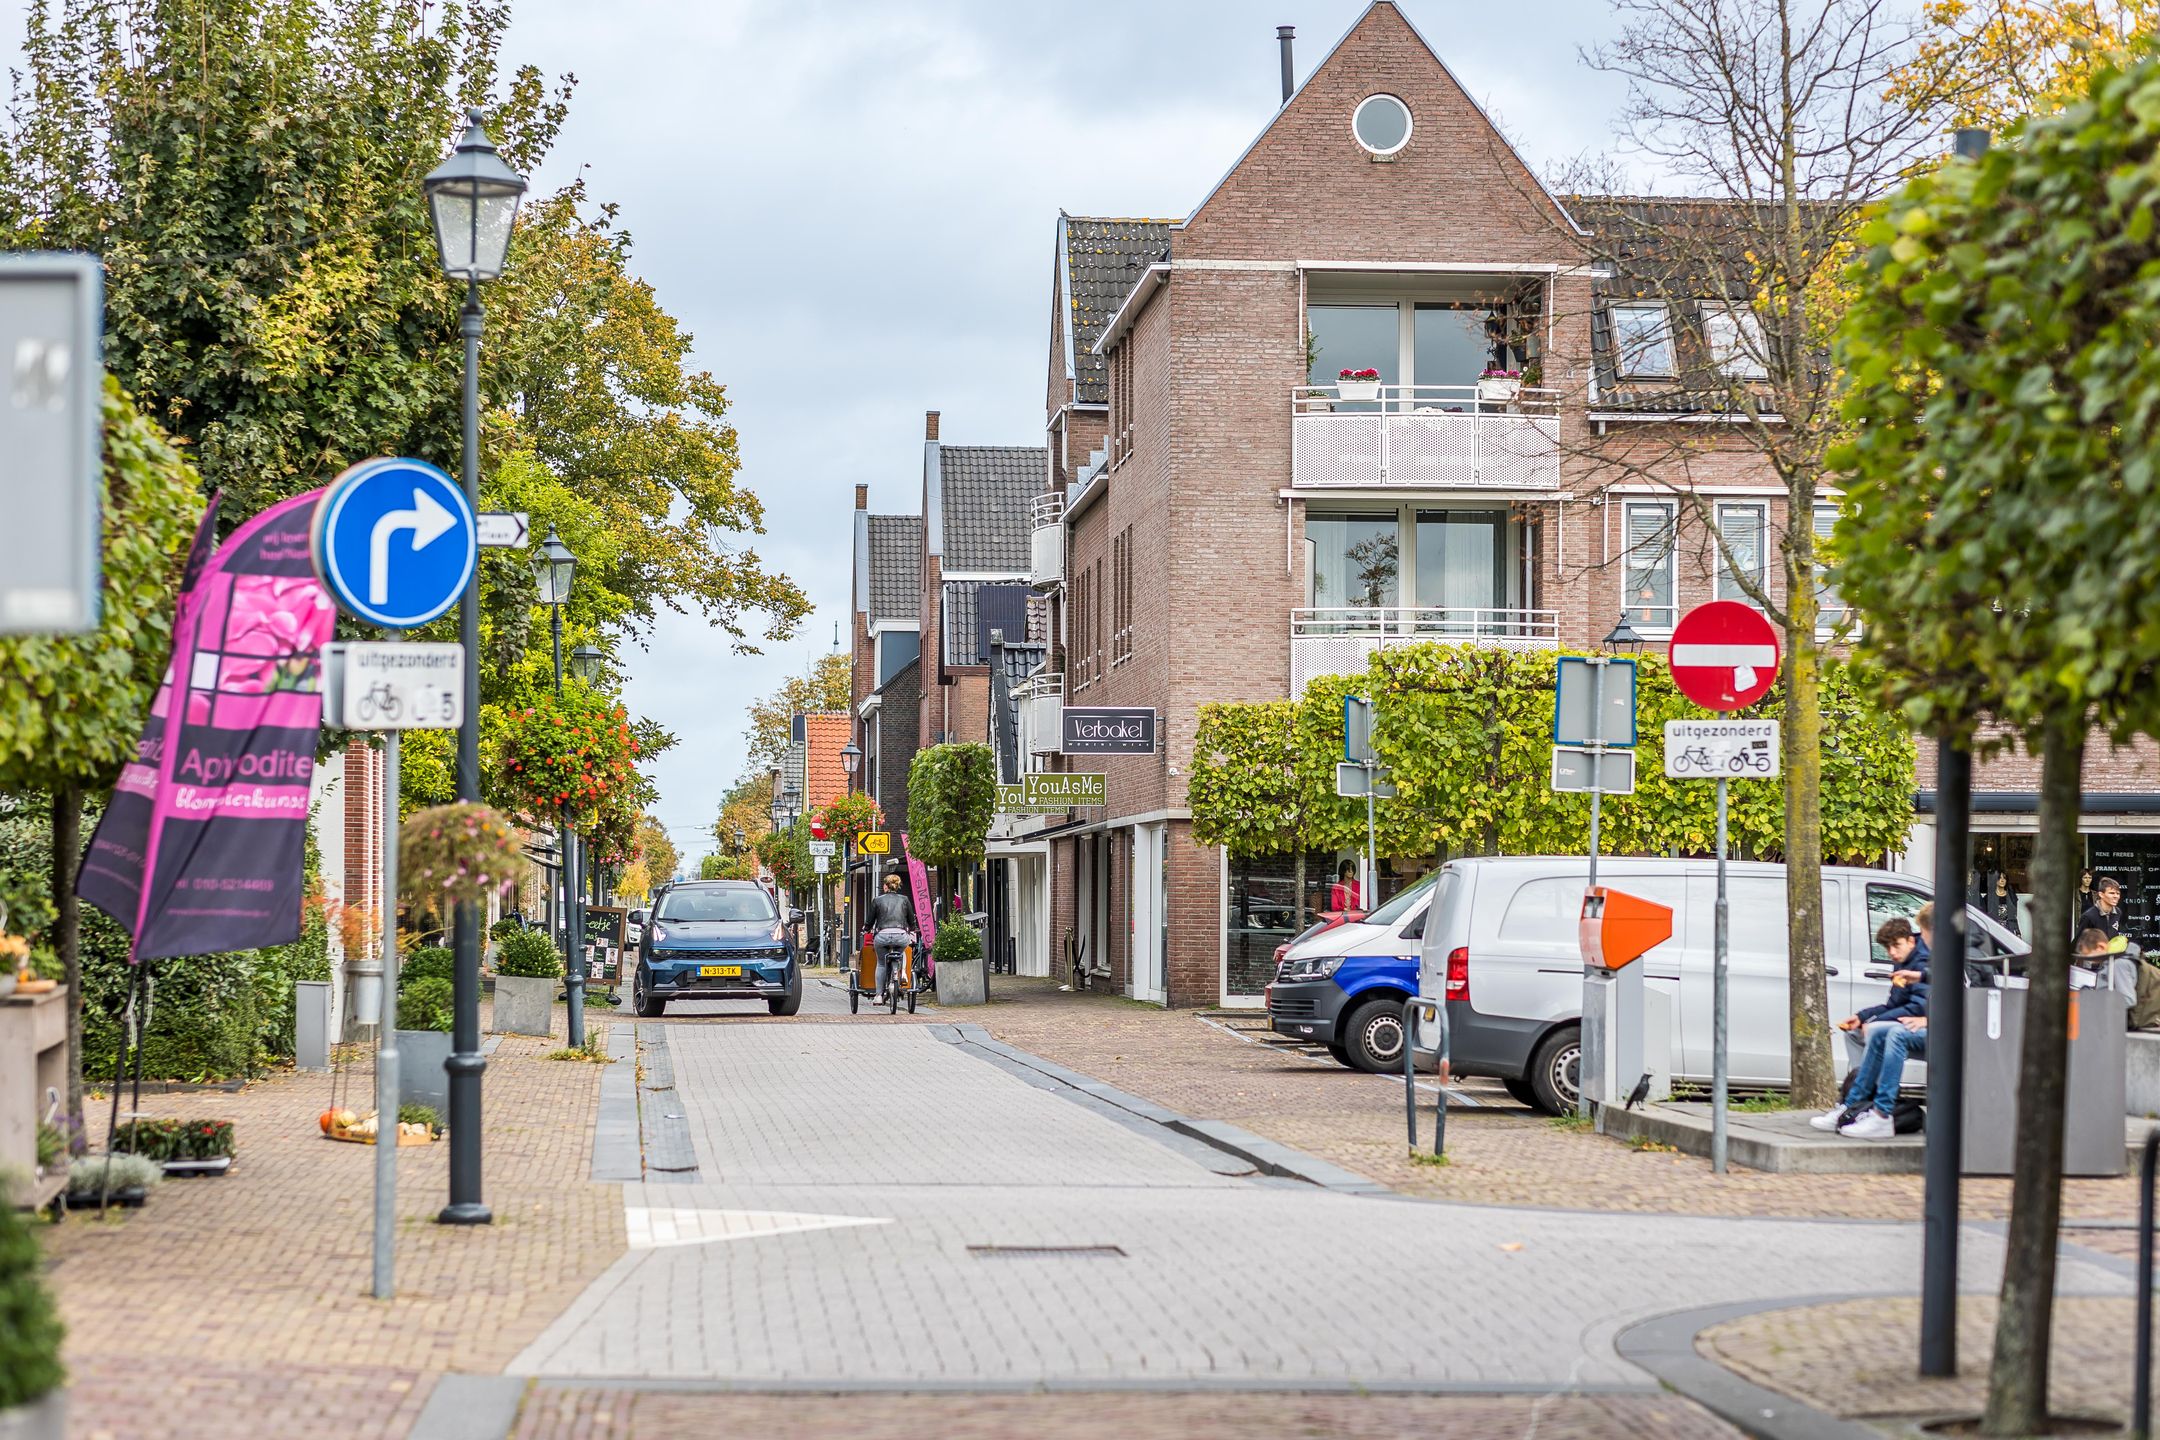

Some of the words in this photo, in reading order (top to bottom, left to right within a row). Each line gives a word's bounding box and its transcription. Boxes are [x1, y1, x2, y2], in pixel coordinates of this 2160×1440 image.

[1074, 719, 1143, 738] Verbakel
[1672, 725, 1771, 739] uitgezonderd
[1028, 776, 1103, 795] YouAsMe
[1039, 797, 1074, 805] FASHION
[1078, 797, 1103, 805] ITEMS
[1007, 806, 1039, 814] FASHION
[1043, 806, 1066, 814] ITEMS
